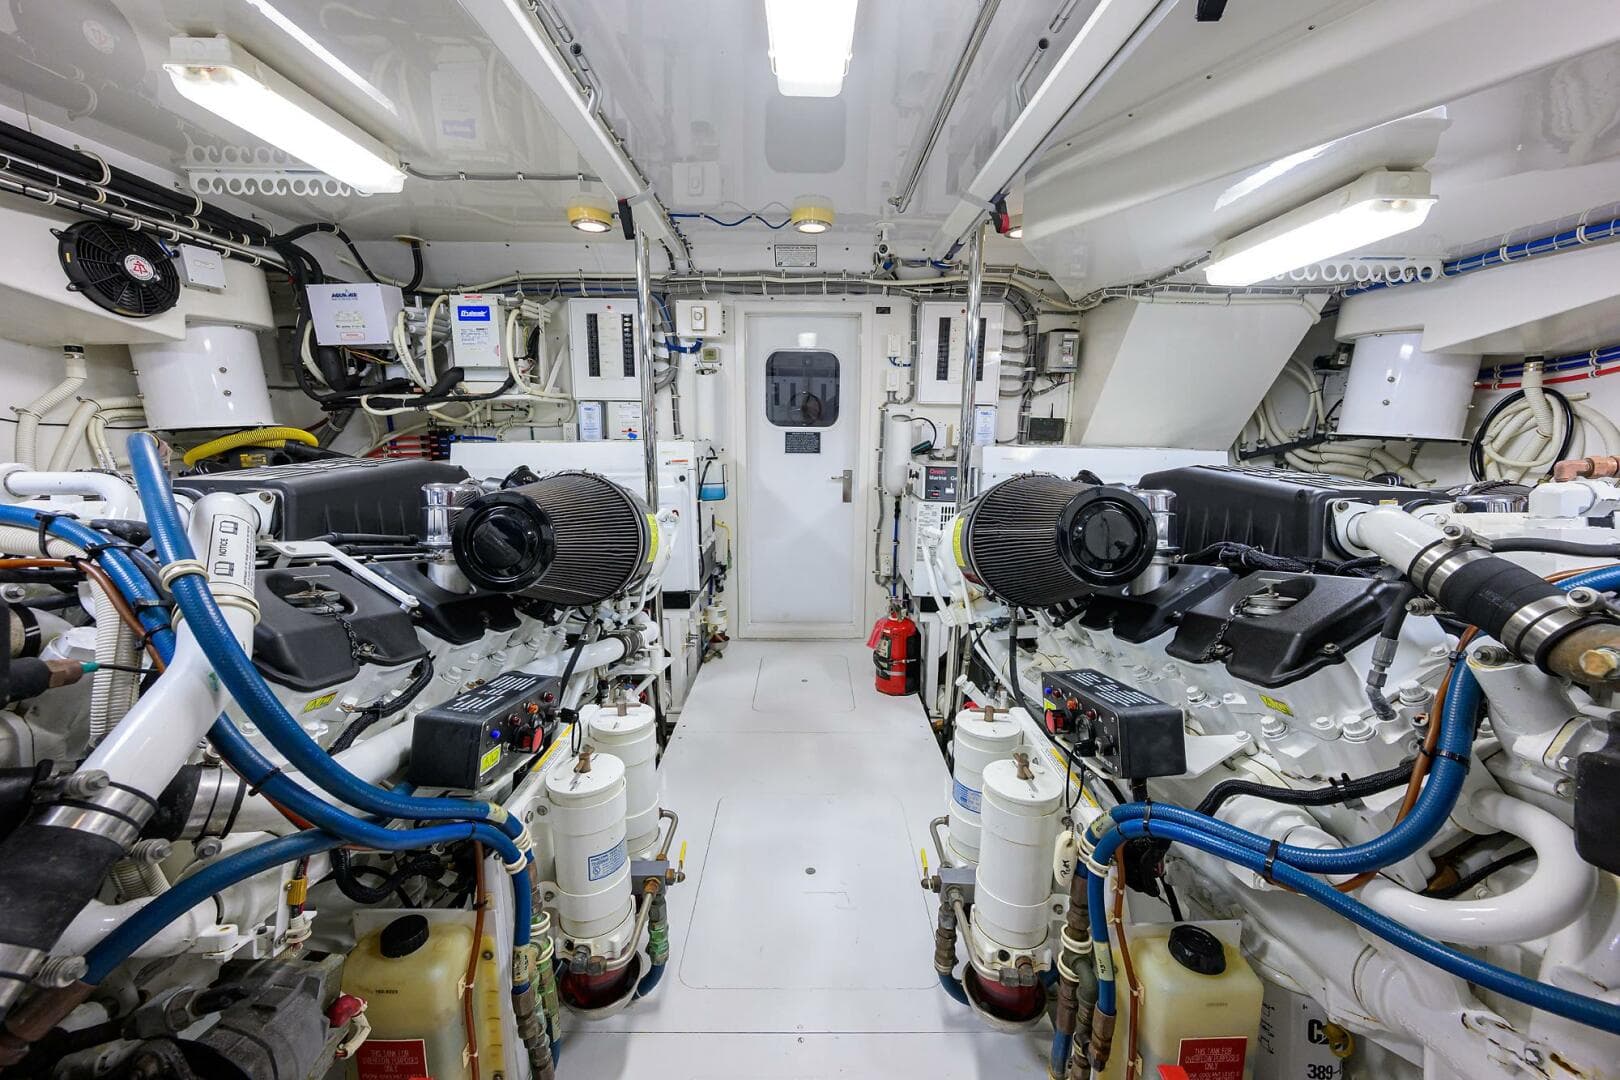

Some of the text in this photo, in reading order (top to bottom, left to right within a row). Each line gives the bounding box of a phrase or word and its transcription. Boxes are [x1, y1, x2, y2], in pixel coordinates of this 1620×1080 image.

[218, 538, 229, 557] NOTICE
[1207, 1047, 1220, 1055] TANK
[1221, 1047, 1233, 1055] FOR
